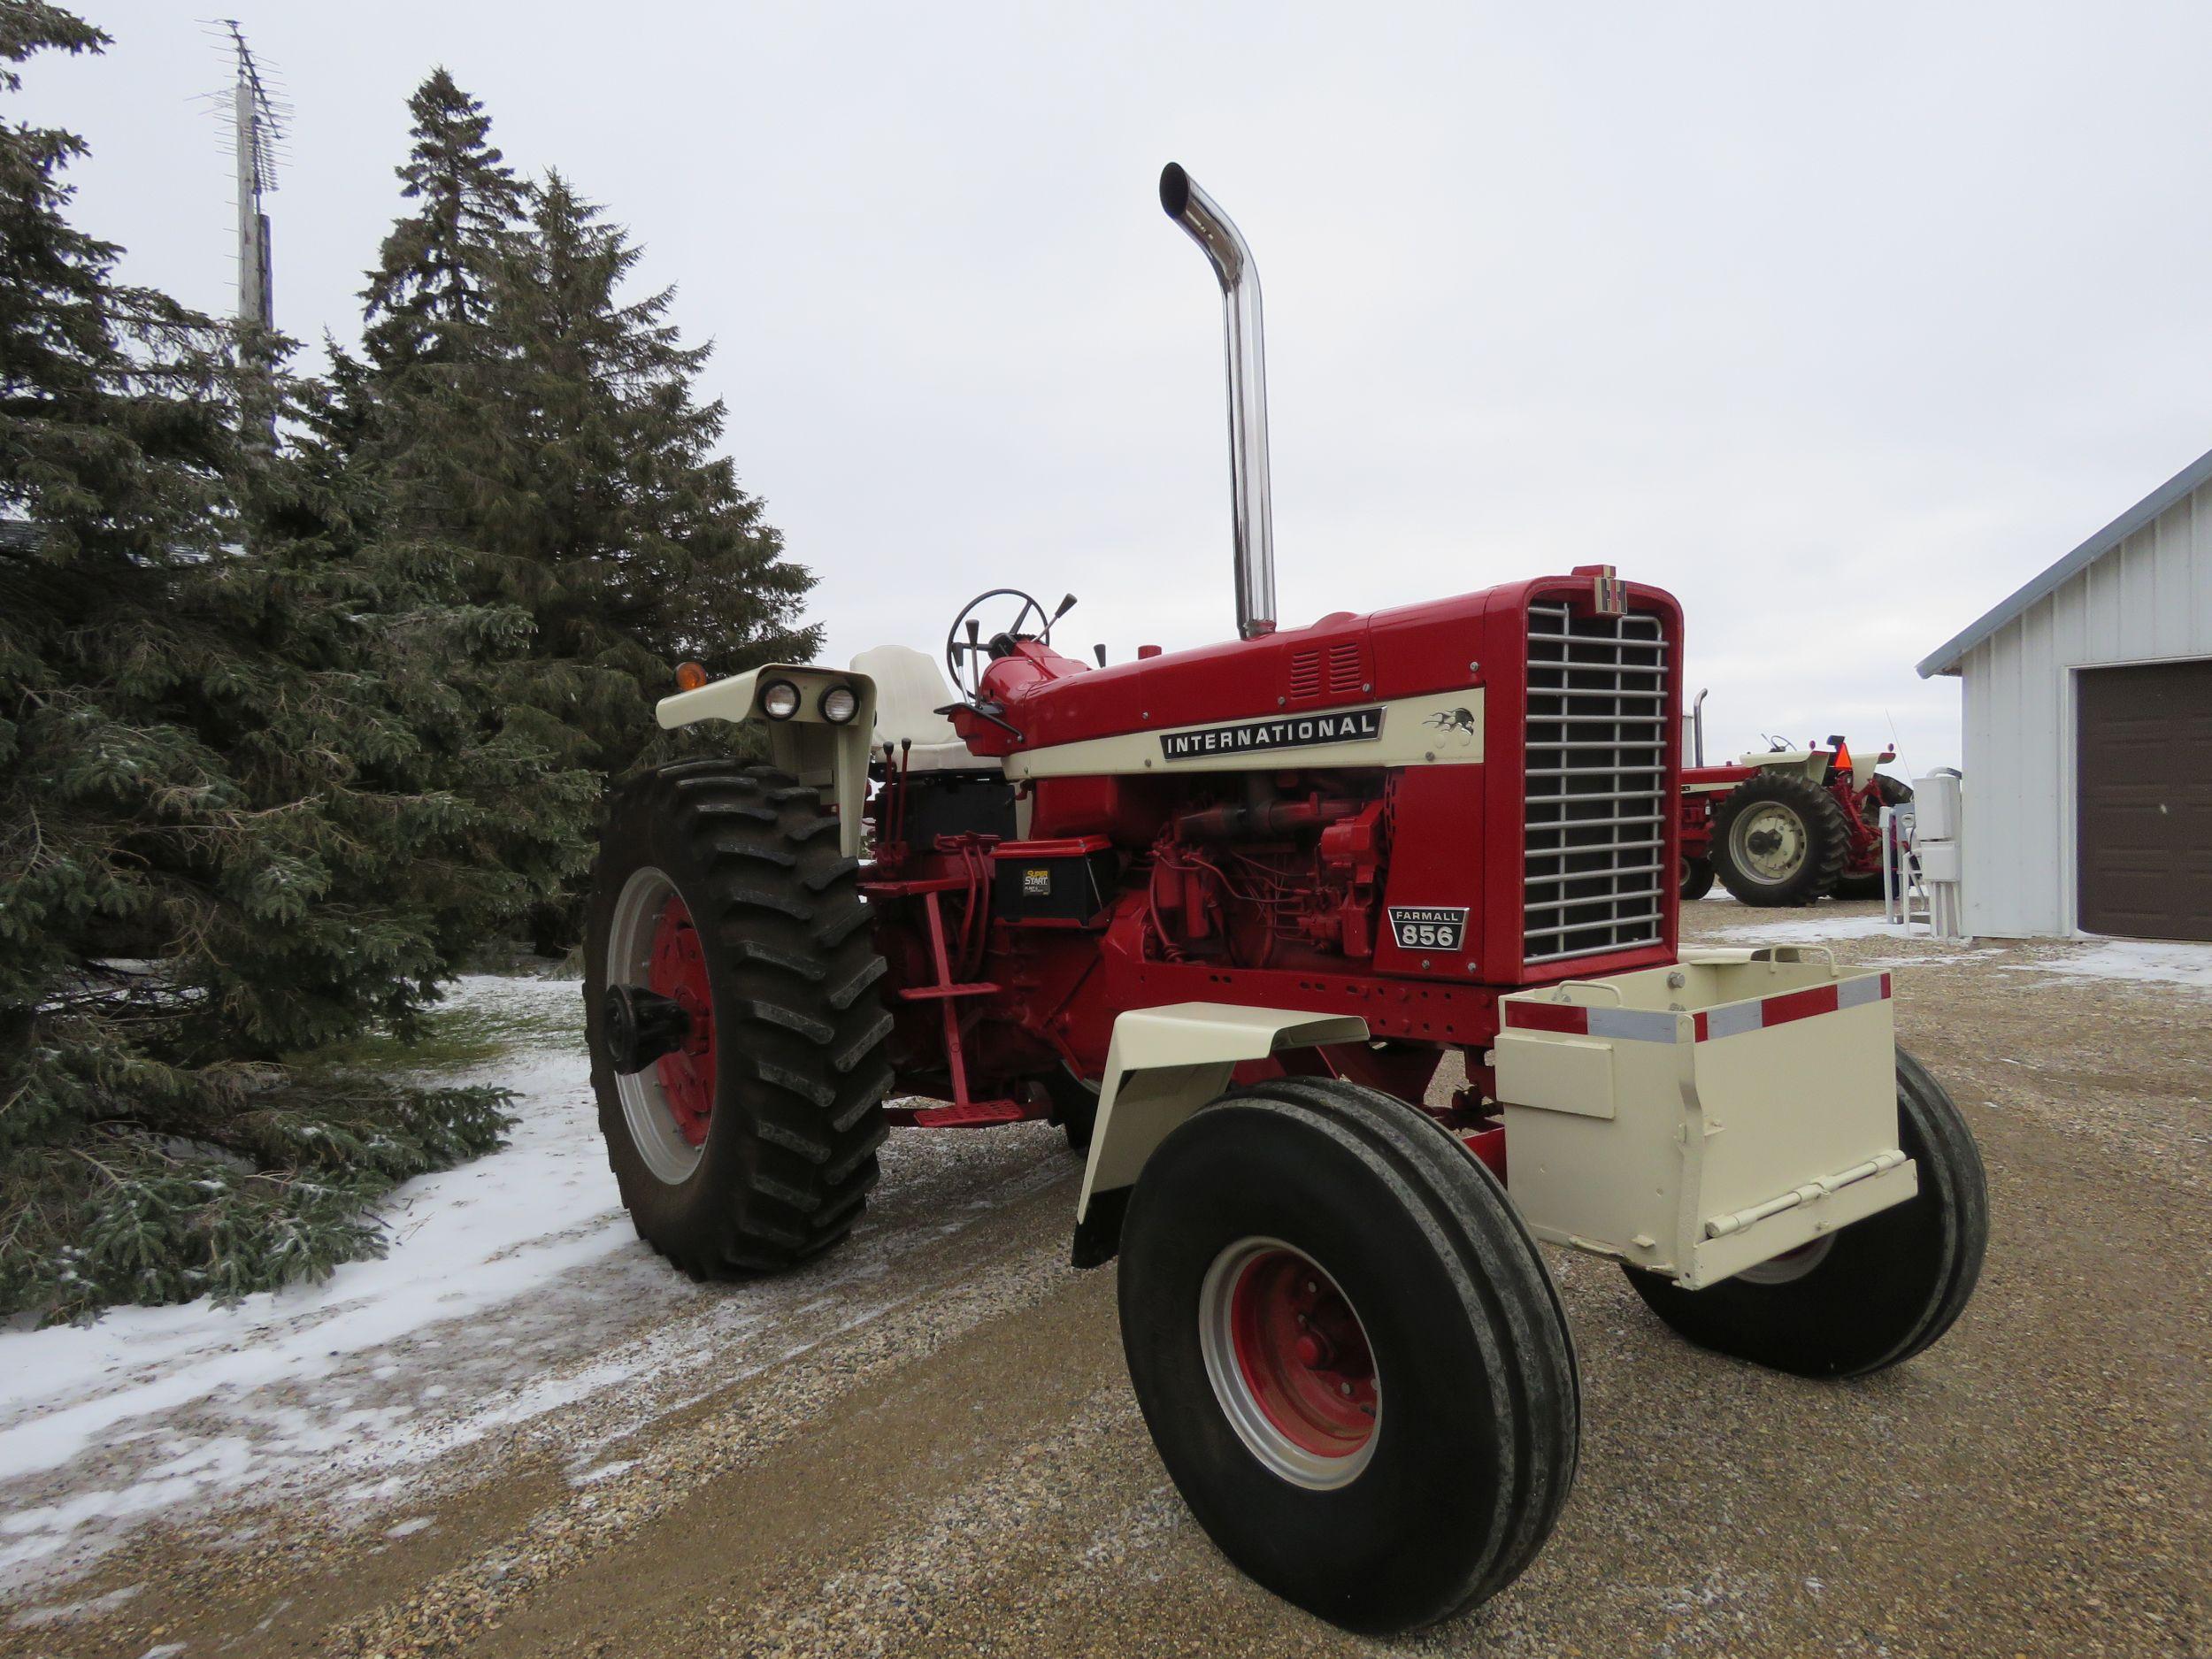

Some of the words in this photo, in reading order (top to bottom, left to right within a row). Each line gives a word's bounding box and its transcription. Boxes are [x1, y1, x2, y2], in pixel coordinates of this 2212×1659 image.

[1167, 715, 1375, 753] INTERNATIONAL
[1025, 876, 1048, 886] START
[1396, 911, 1458, 921] FARMALL
[1402, 925, 1454, 947] 856
